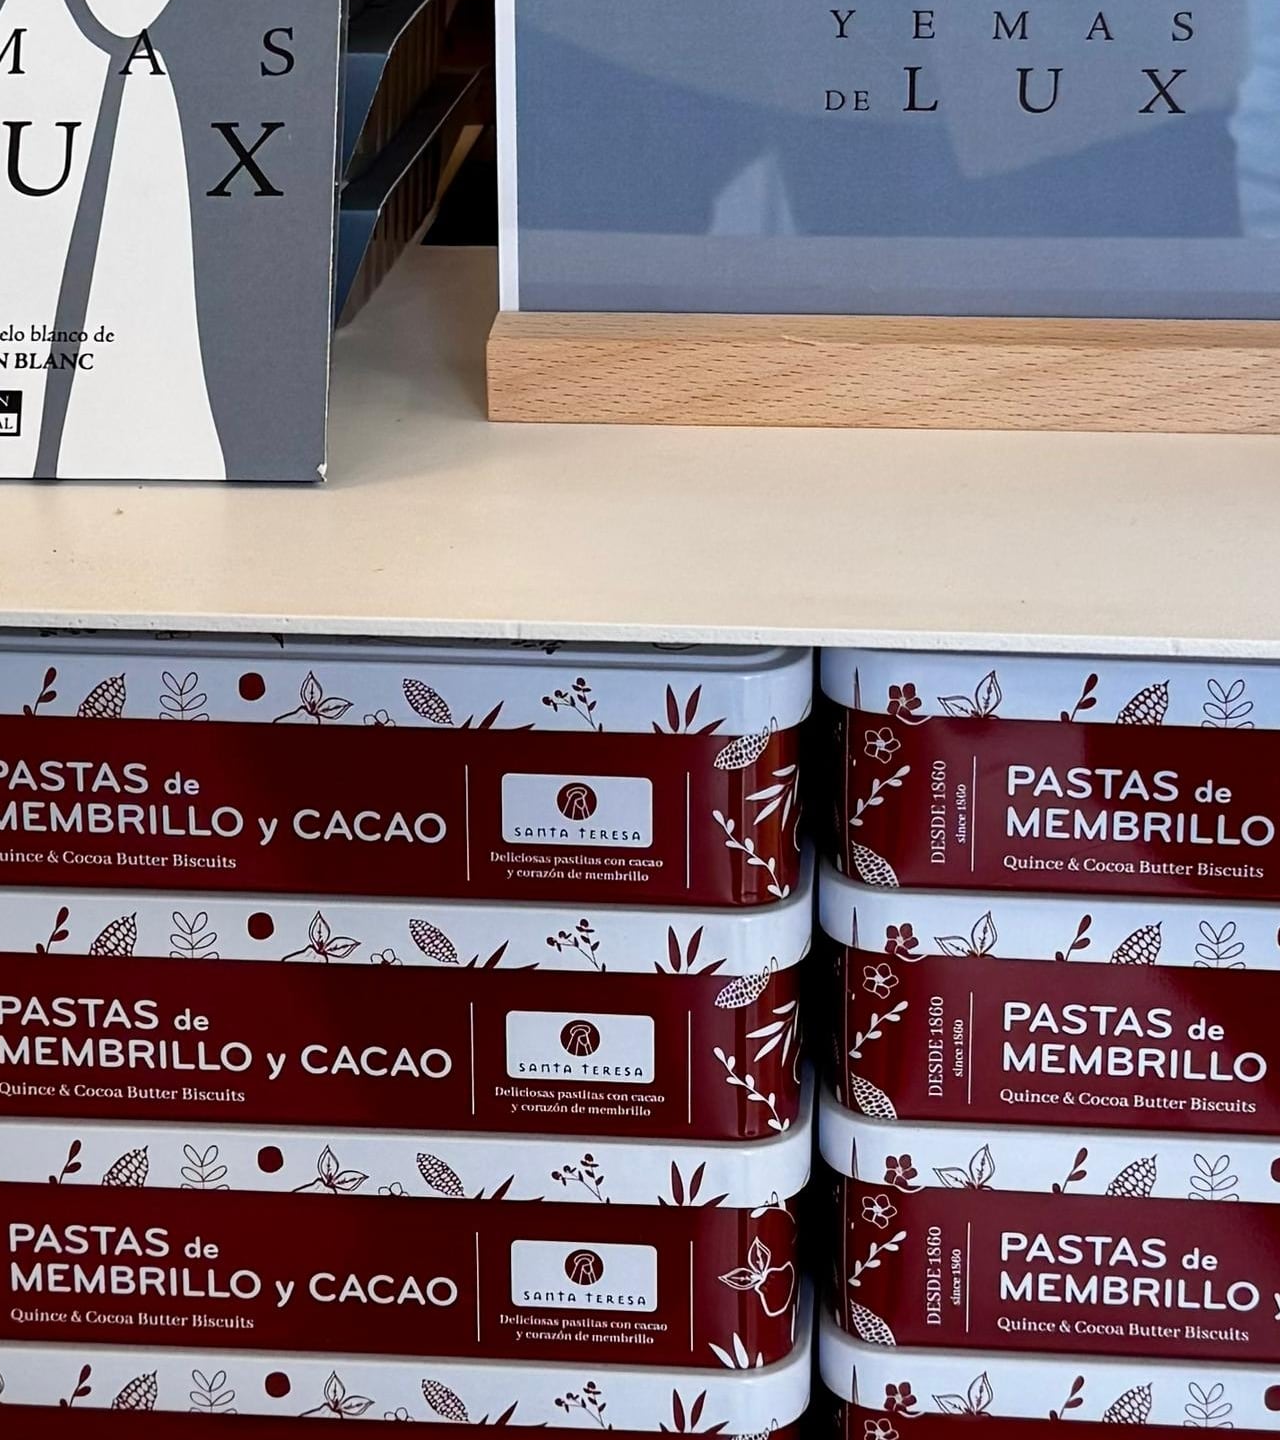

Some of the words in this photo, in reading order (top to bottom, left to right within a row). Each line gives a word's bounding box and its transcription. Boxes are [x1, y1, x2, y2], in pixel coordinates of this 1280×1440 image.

[829, 9, 1195, 43] YEMAS
[824, 88, 871, 112] DE
[902, 66, 1188, 115] LUX
[30, 324, 90, 344] blanco
[95, 325, 116, 344] de
[14, 351, 94, 371] BLANC
[163, 771, 200, 796] de
[931, 760, 946, 799] 1860
[1008, 765, 1179, 802] PASTAS
[1194, 779, 1232, 804] de
[257, 817, 278, 846] y
[293, 808, 447, 844] CACAO
[930, 804, 946, 864] DESDE
[1006, 806, 1275, 847] MEMBRILLO
[1003, 855, 1064, 871] Quince
[1067, 857, 1080, 871] &
[1083, 858, 1135, 873] Cocoa
[1139, 860, 1194, 876] Butter
[1197, 862, 1264, 878] Biscuits
